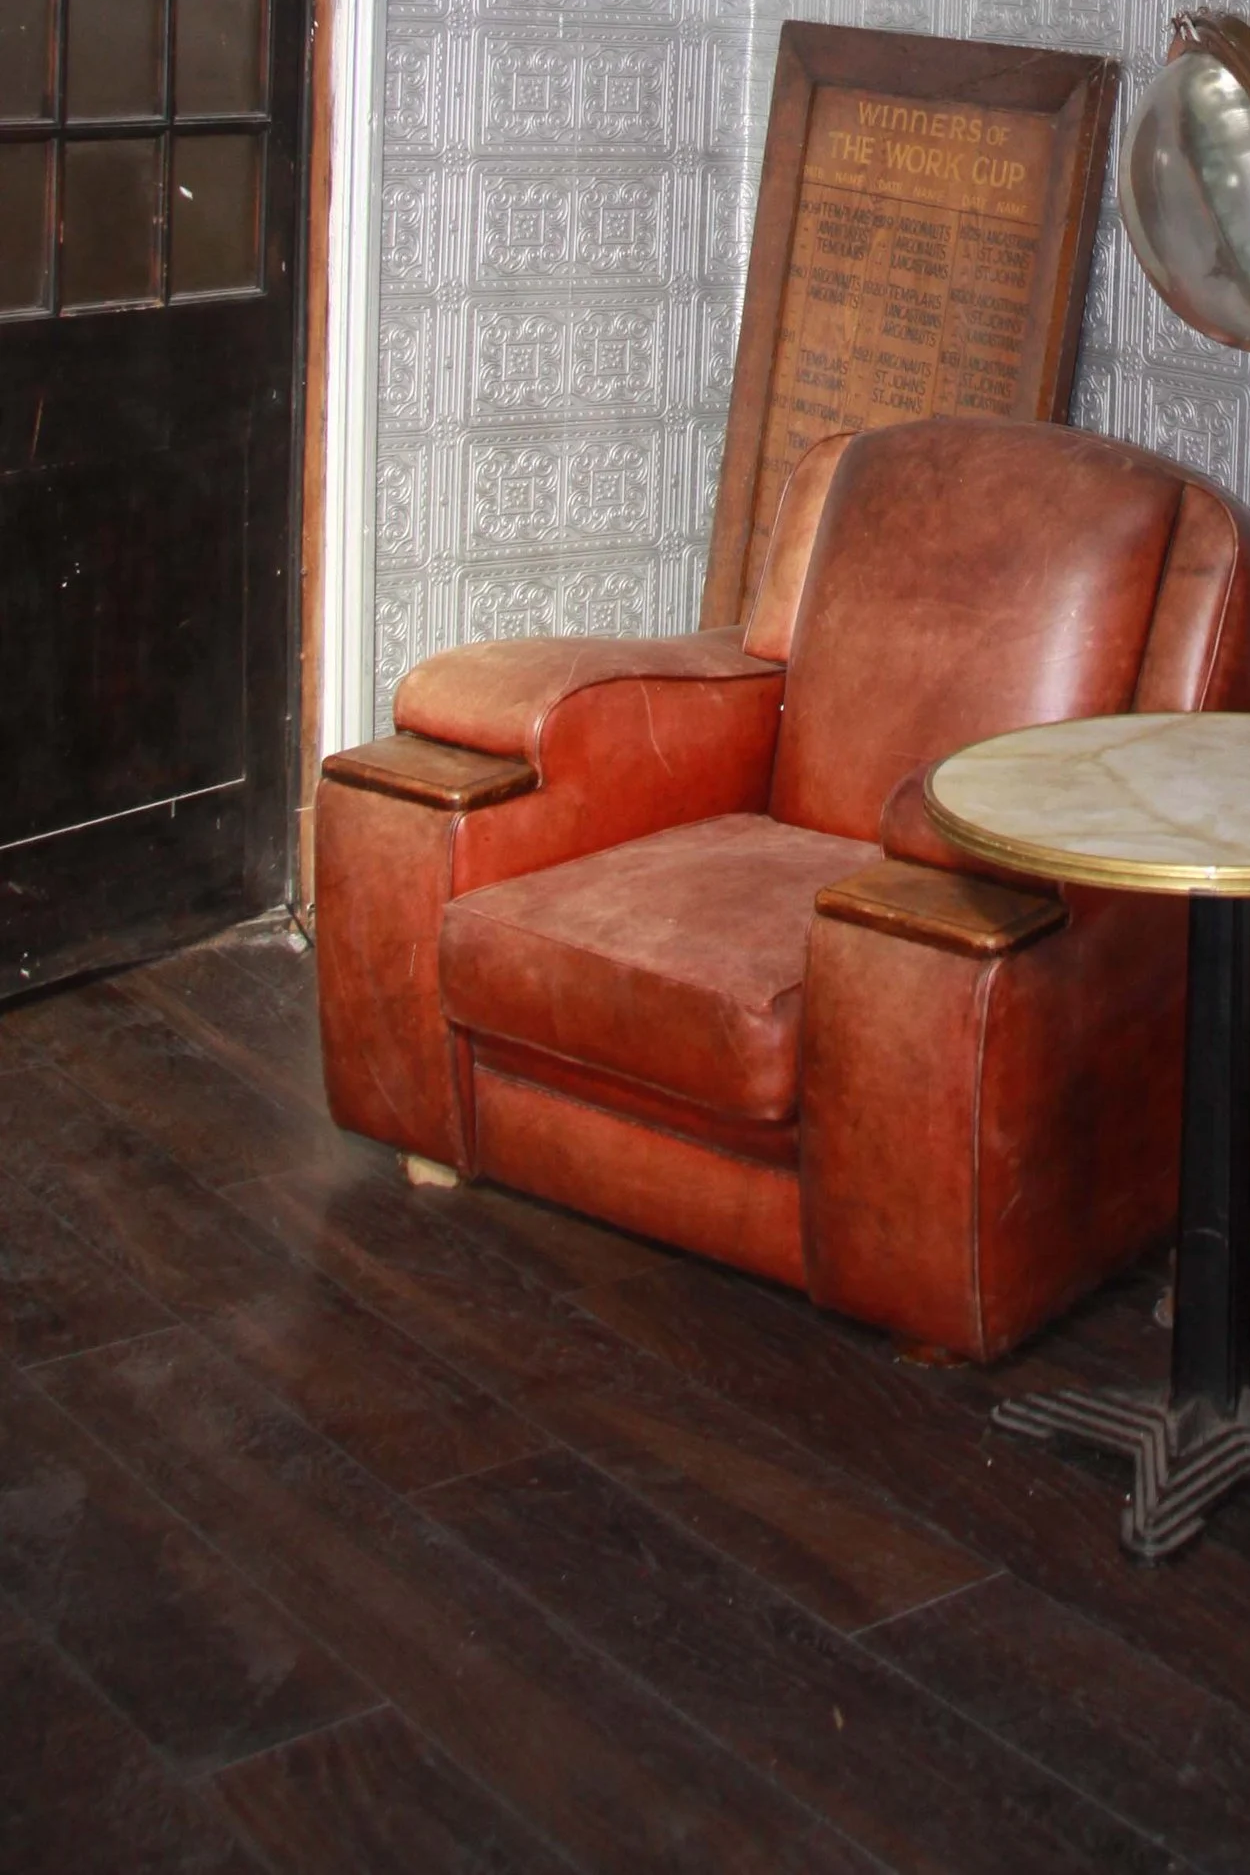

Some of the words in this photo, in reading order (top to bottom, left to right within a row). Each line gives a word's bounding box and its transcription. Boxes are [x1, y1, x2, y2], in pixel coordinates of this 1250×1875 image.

[986, 125, 1011, 148] OF
[828, 131, 875, 165] THE
[886, 140, 964, 181] WORK
[971, 155, 1027, 190] CUP
[835, 172, 865, 185] NAME
[879, 178, 903, 194] DATE
[913, 186, 946, 203] NAME
[997, 201, 1028, 216] NAME
